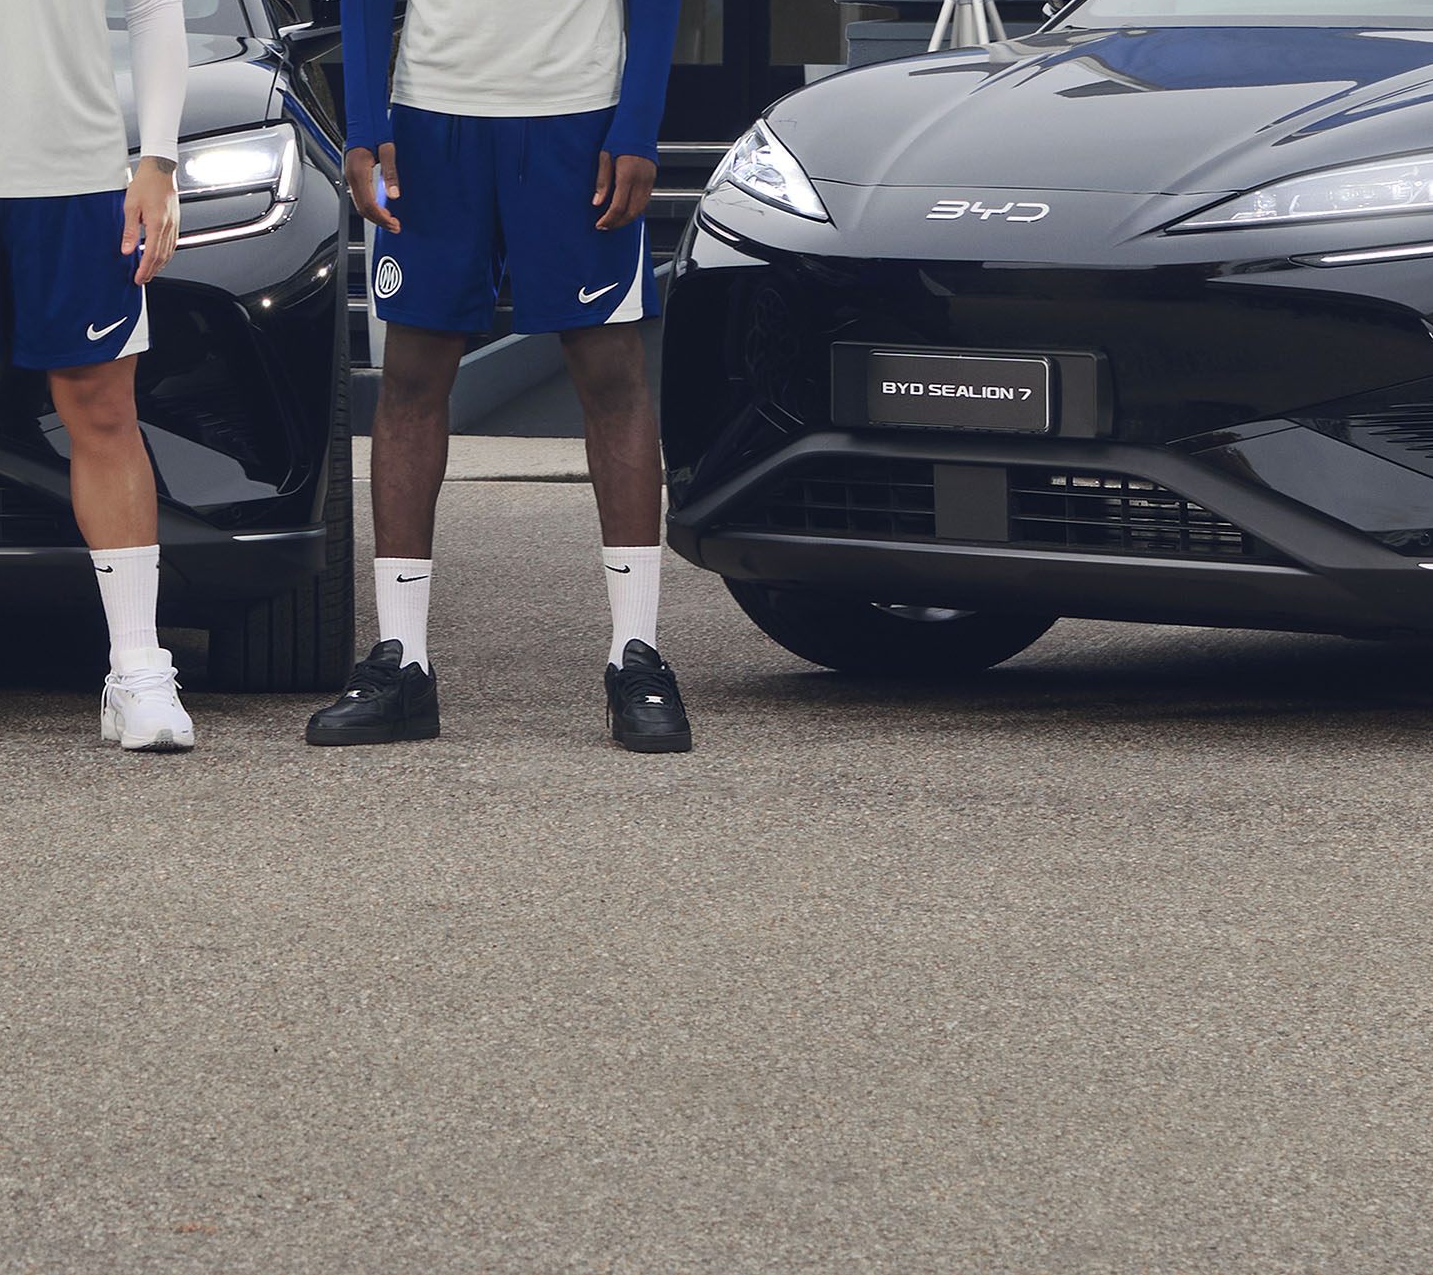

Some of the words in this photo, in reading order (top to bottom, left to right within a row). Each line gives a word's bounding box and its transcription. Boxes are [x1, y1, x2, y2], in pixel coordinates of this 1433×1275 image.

[926, 201, 1050, 223] BYD
[883, 382, 923, 395] BYD
[928, 384, 1013, 399] SEALION
[1018, 388, 1031, 400] 7
